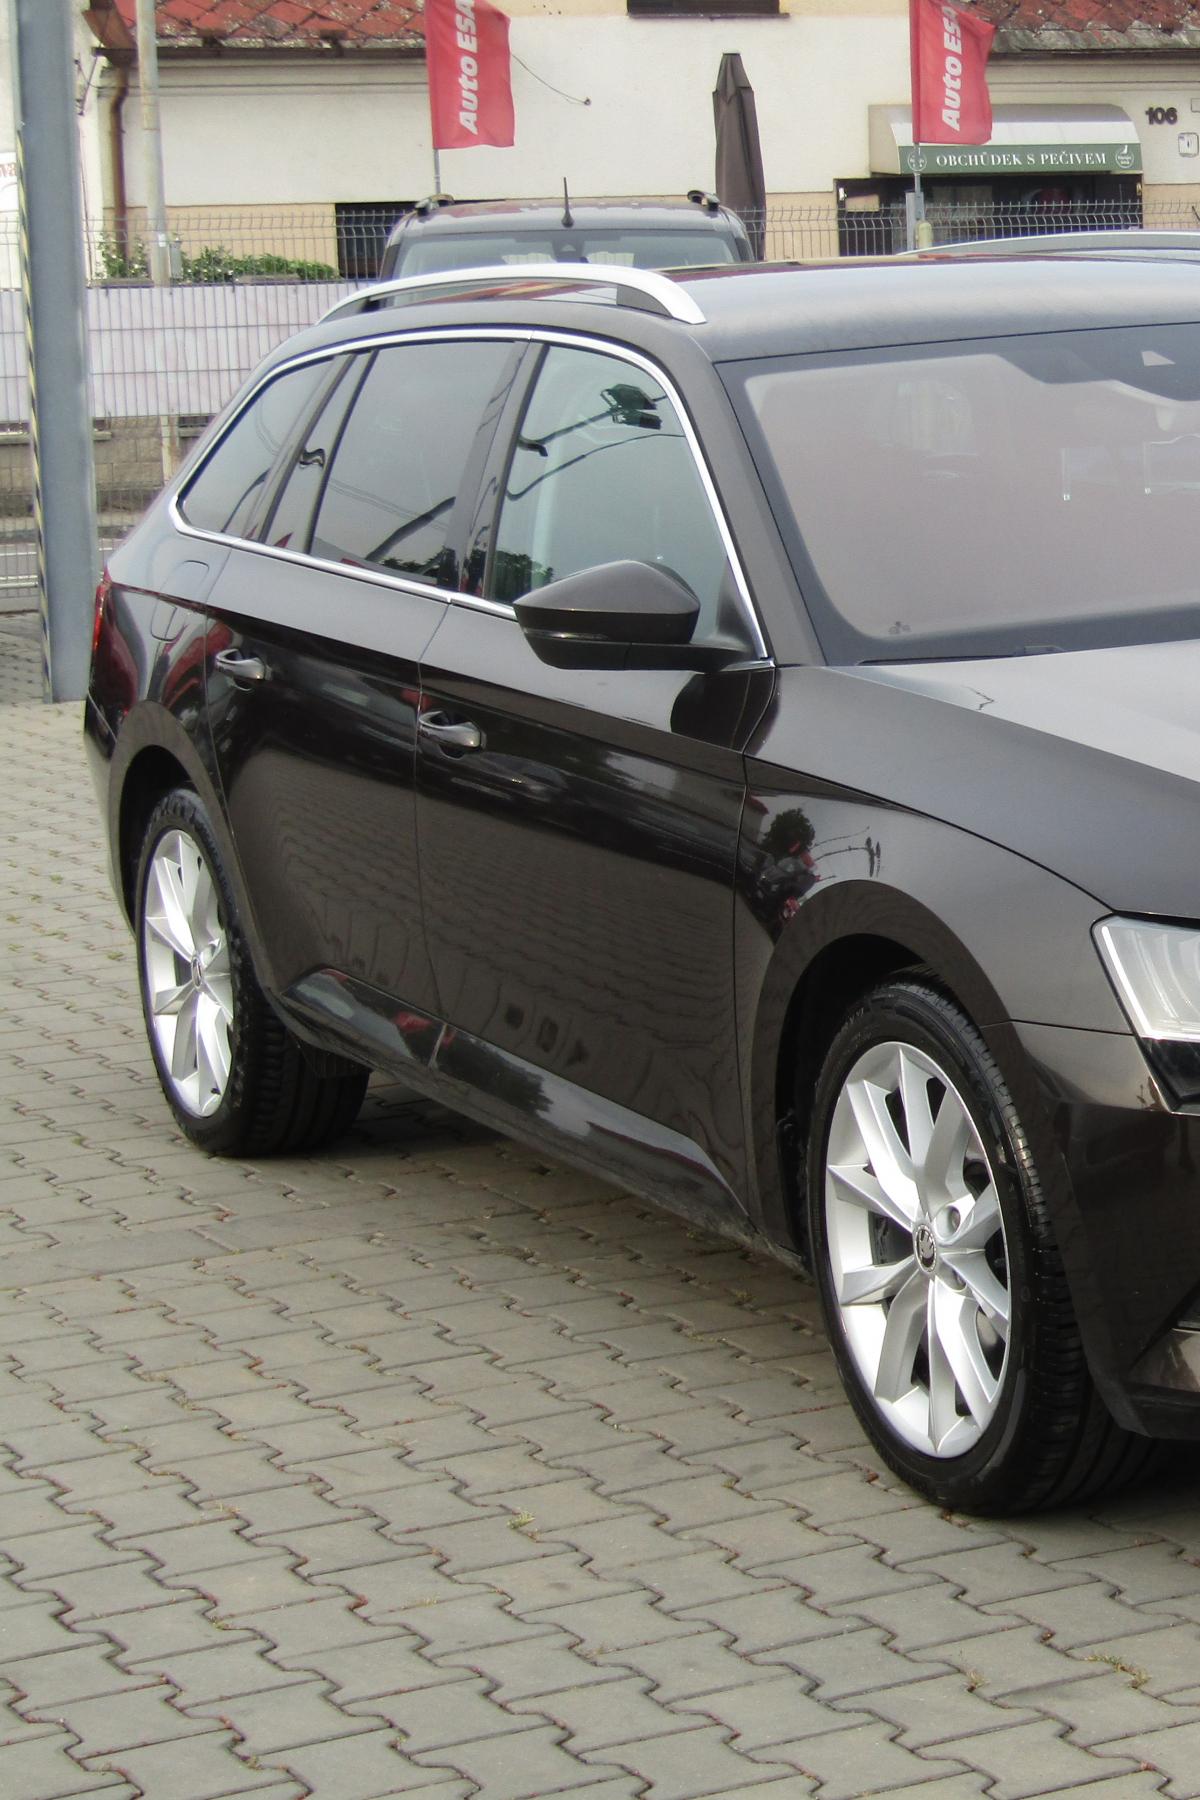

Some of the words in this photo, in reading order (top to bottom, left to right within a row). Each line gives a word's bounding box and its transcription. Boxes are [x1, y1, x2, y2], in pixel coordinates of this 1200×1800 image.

[454, 0, 478, 54] ESA
[458, 55, 479, 136] Auto
[942, 55, 962, 132] Auto
[1145, 107, 1178, 125] 106
[1027, 153, 1036, 166] S
[1041, 150, 1107, 166] PEČIVEM
